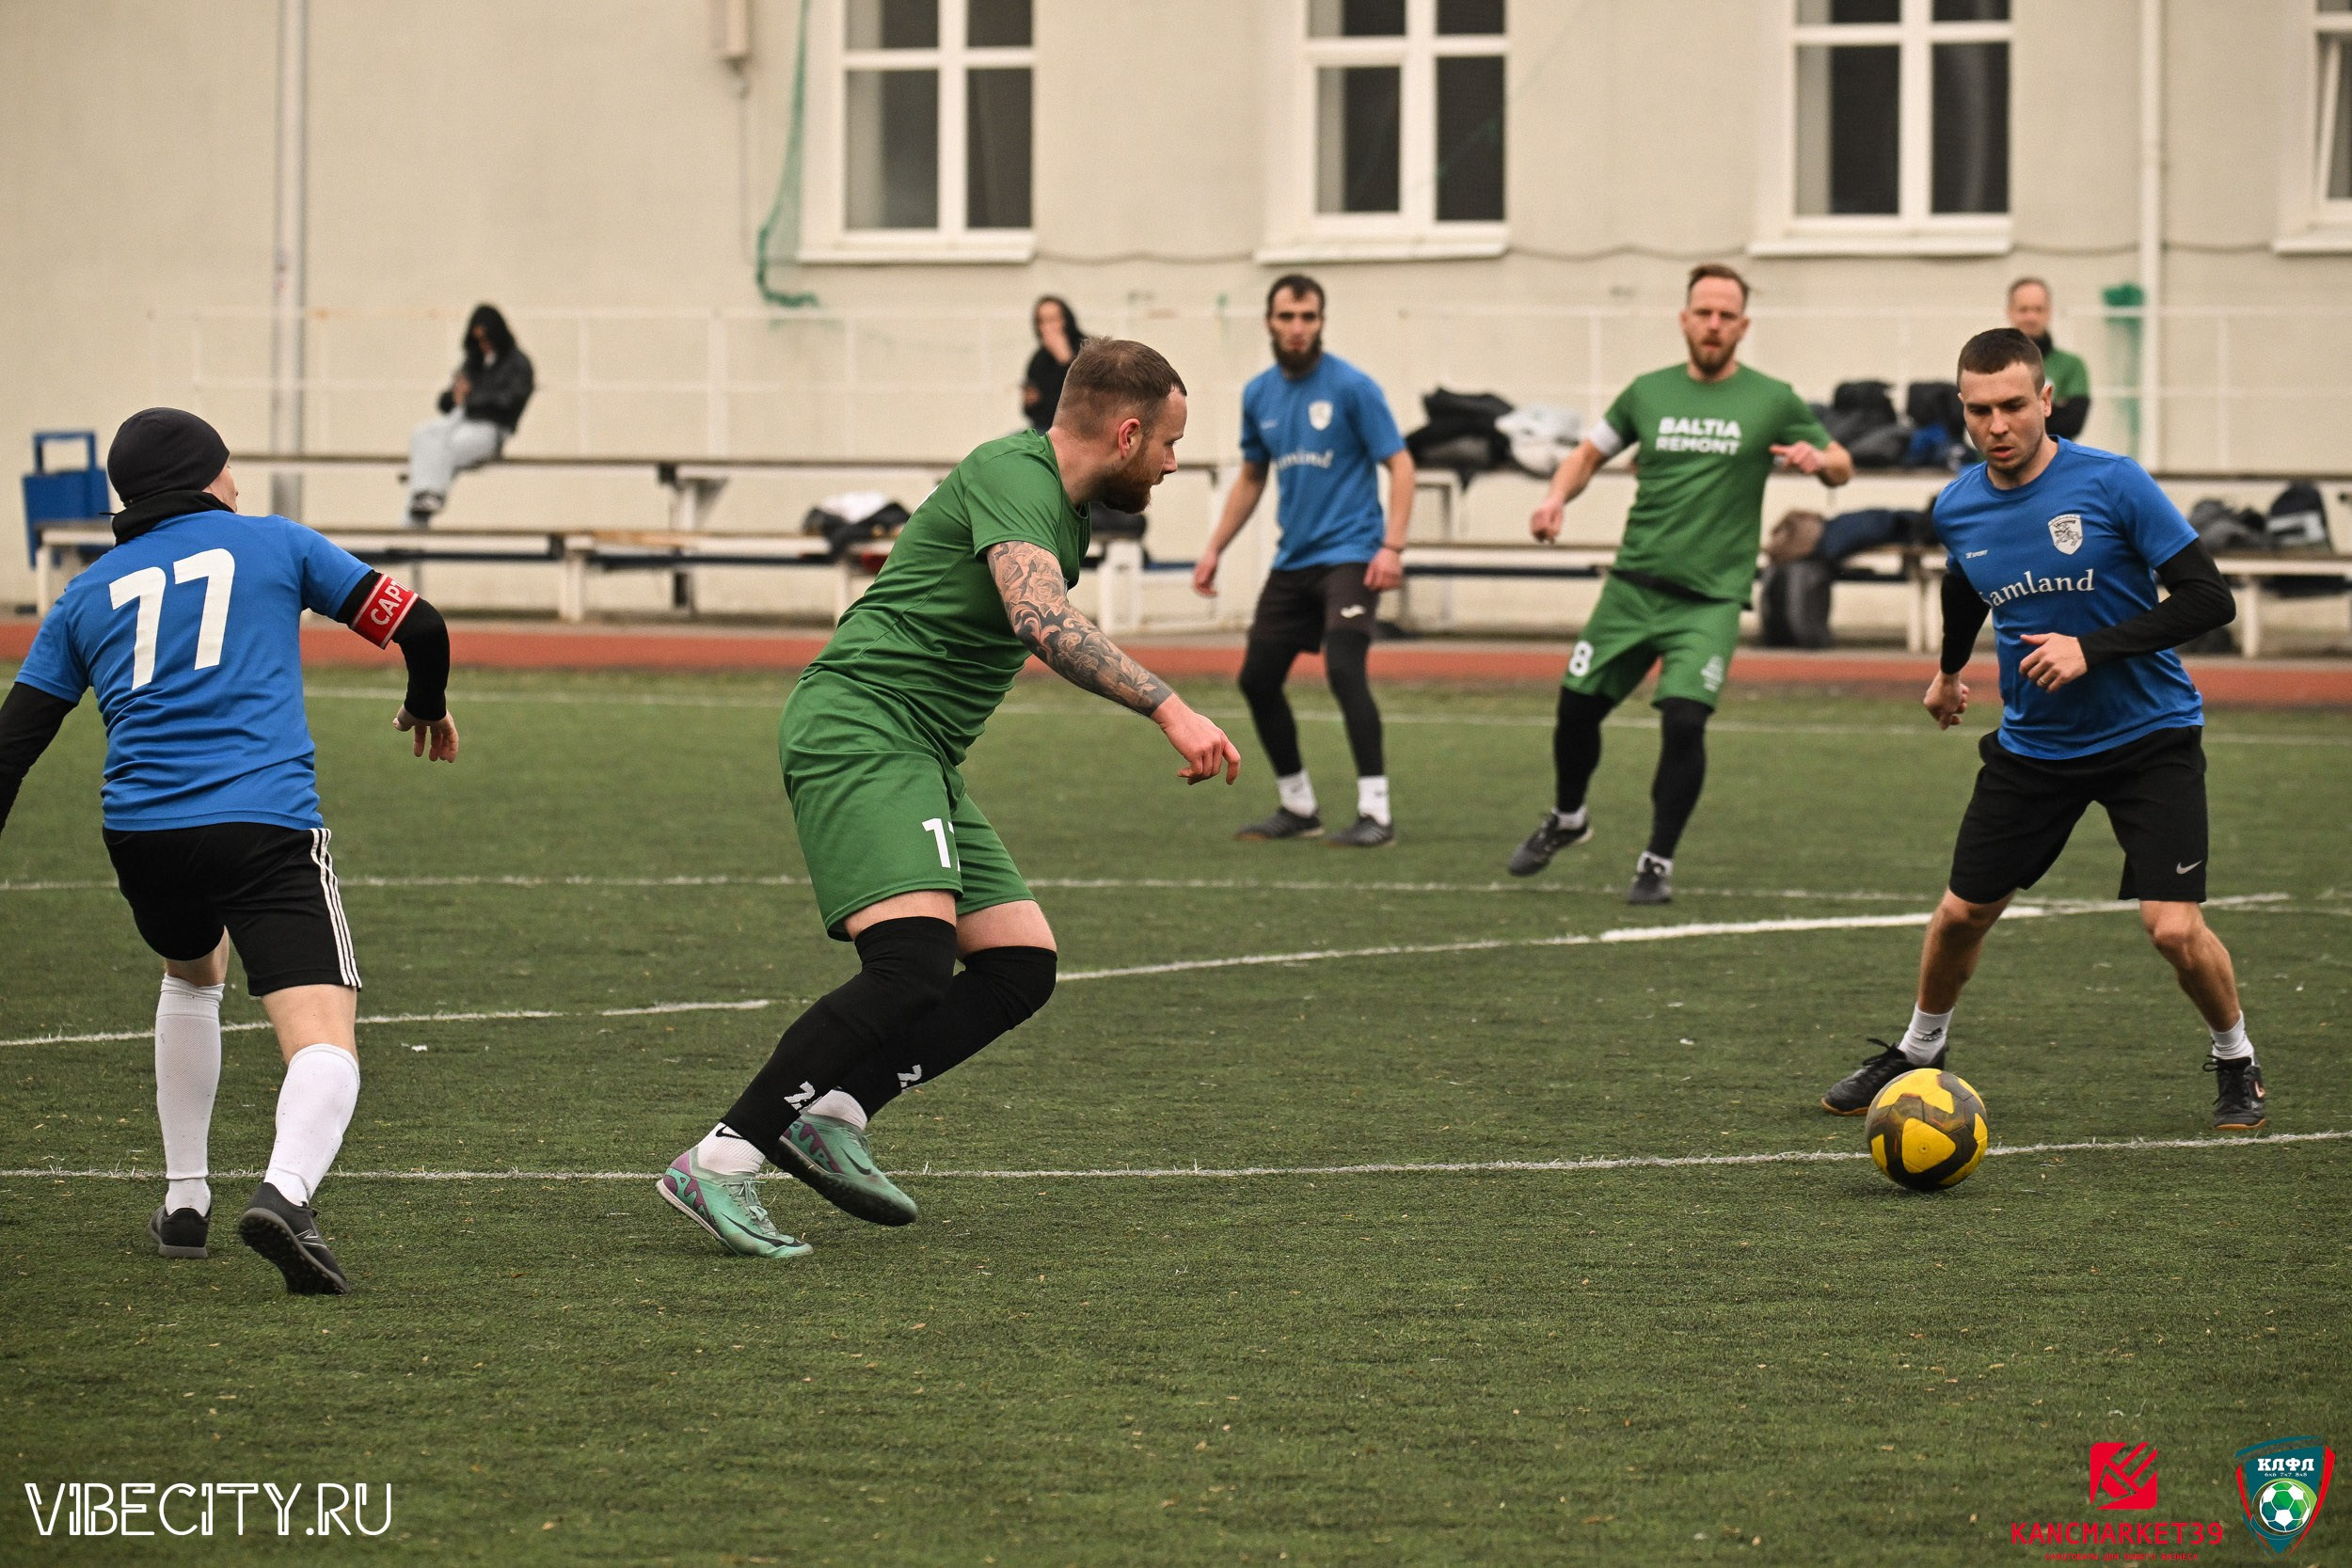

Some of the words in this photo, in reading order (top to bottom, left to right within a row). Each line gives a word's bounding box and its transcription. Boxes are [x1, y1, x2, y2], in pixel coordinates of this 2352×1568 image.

[1656, 436, 1740, 456] REMONT
[1658, 417, 1742, 439] BALTIA
[109, 547, 235, 690] 77
[1568, 640, 1595, 677] 8
[922, 817, 961, 872] 1
